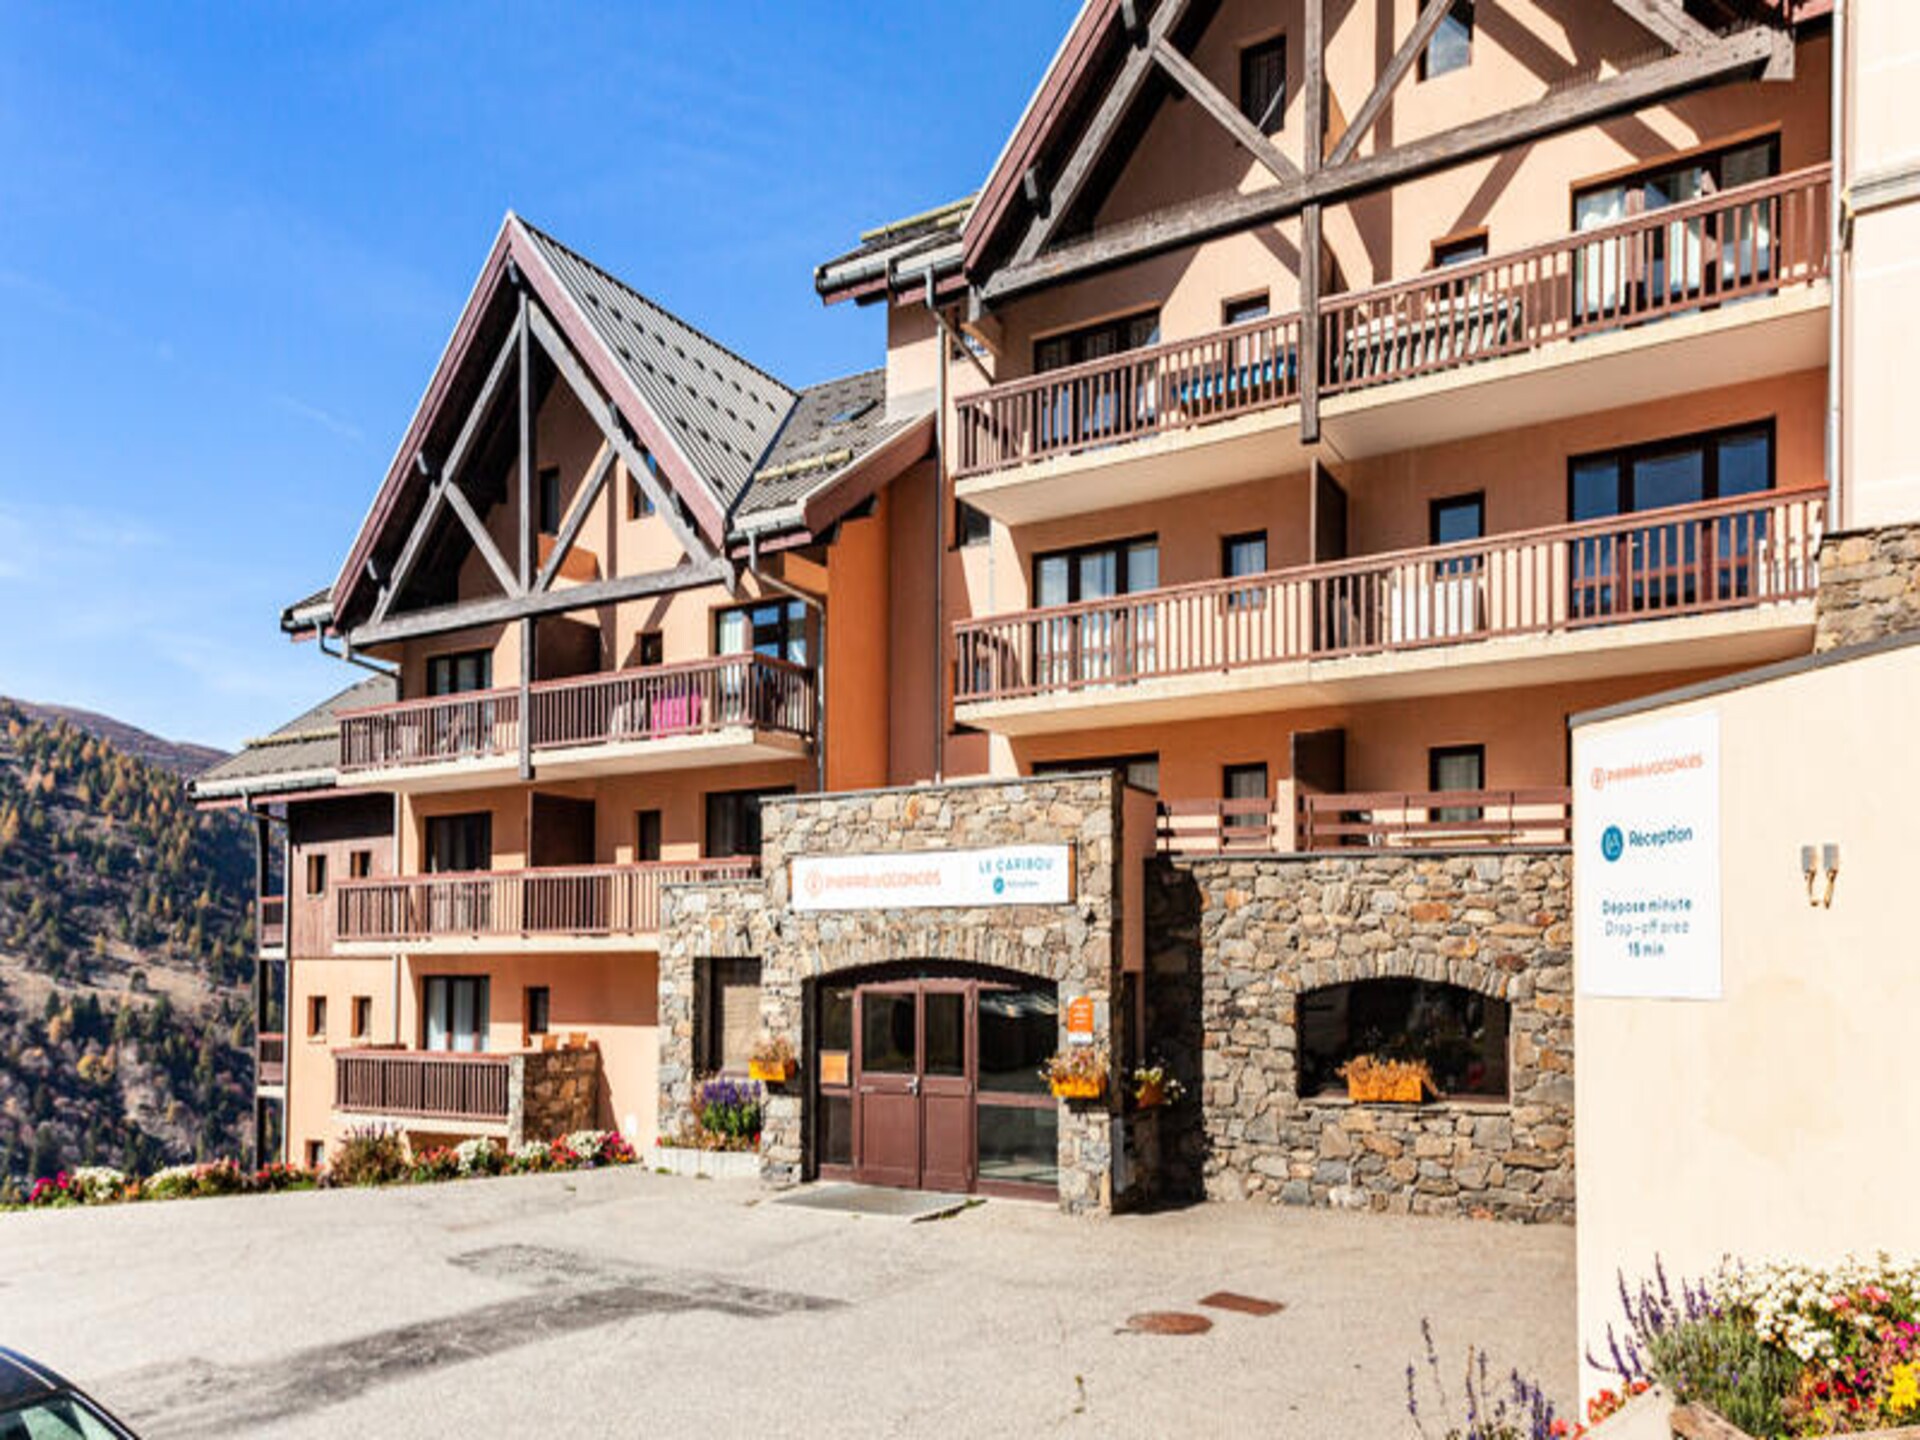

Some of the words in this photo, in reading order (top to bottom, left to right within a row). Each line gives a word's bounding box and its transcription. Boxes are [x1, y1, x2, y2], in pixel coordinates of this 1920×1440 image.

[978, 859, 992, 875] LE
[995, 856, 1053, 873] CARIBOU
[1648, 896, 1692, 913] minute
[1643, 941, 1664, 956] min
